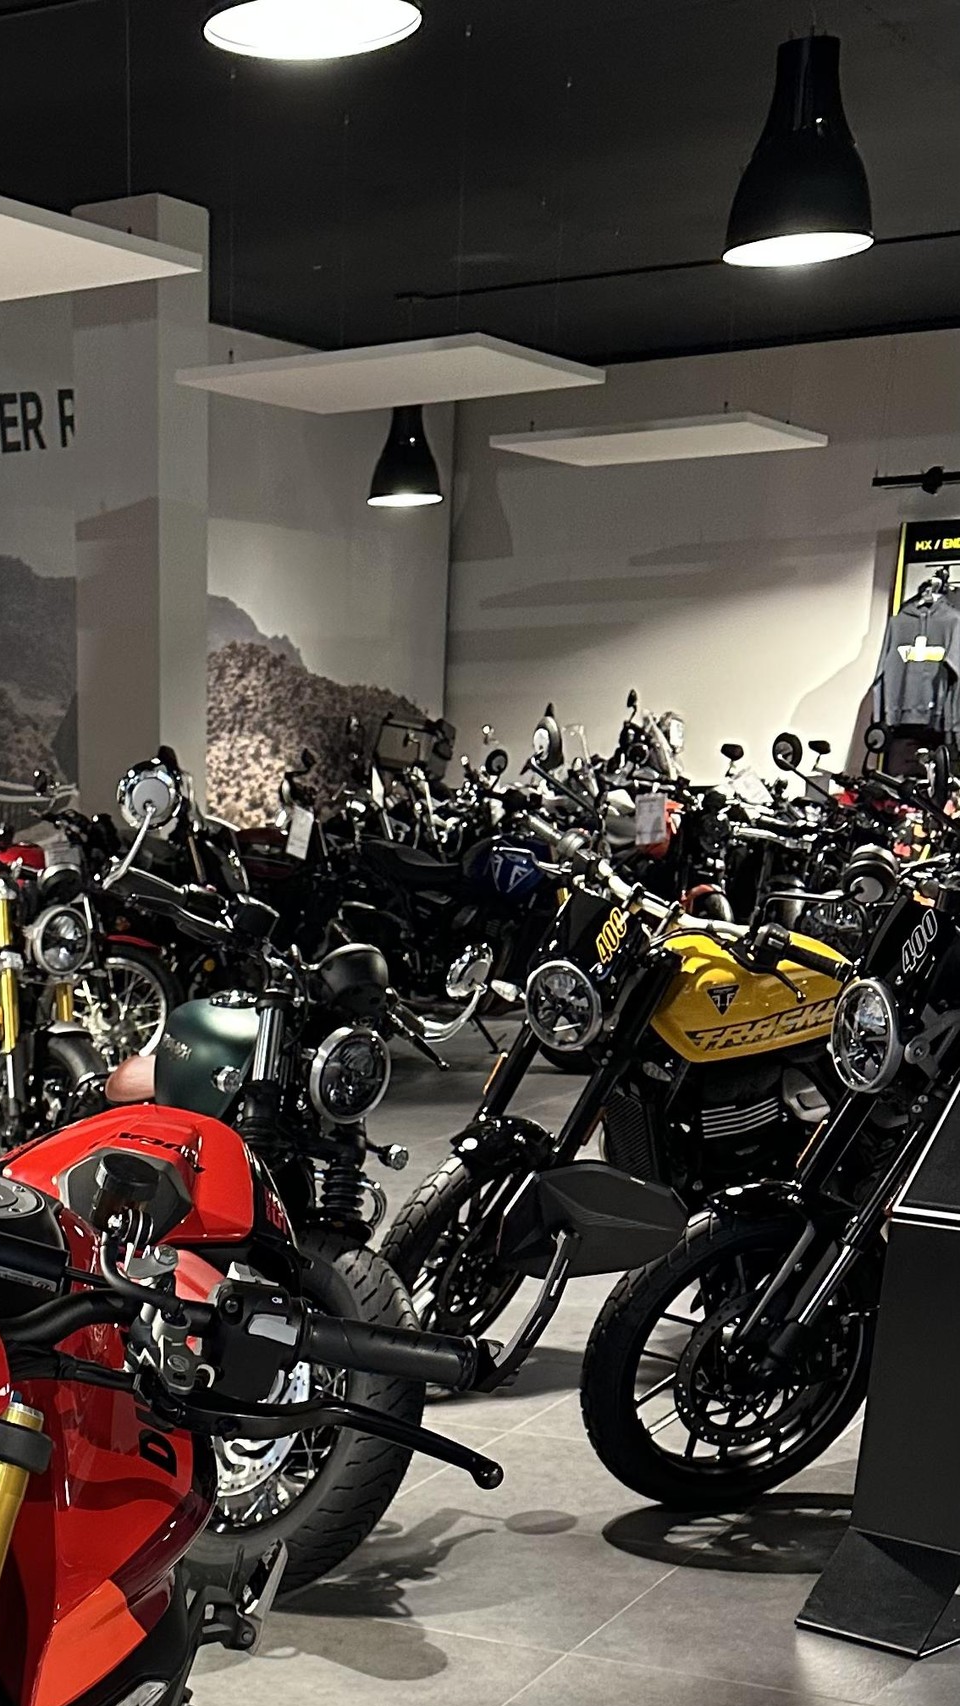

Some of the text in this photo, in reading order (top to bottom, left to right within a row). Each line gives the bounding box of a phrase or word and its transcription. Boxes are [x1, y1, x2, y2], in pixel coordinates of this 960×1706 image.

[915, 540, 932, 551] MX
[596, 907, 627, 964] 400
[902, 908, 938, 974] 400
